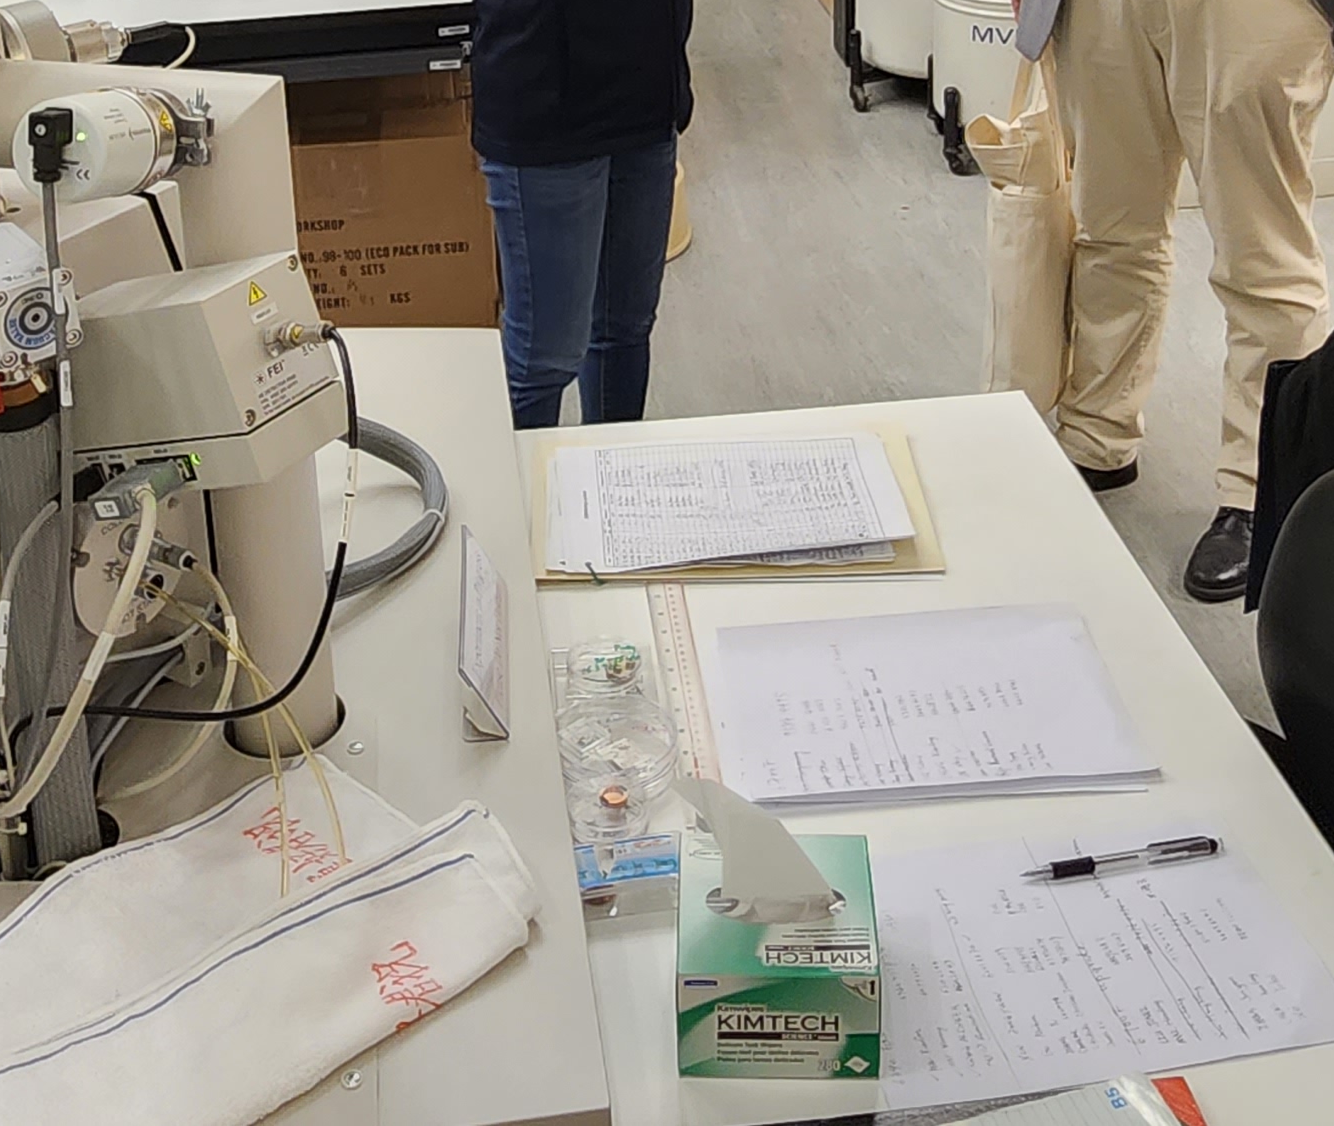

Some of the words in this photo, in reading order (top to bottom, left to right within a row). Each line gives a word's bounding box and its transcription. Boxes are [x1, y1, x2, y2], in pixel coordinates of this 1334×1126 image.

[393, 244, 419, 258] PACK
[422, 243, 441, 256] FOR
[444, 241, 470, 254] SUB)
[339, 264, 348, 277] 6
[359, 262, 386, 276] SETS
[390, 292, 411, 305] KGS
[267, 360, 284, 378] FEI
[766, 952, 872, 964] KIMTECH
[869, 980, 876, 996] 1
[717, 1015, 839, 1031] KIMTECH
[1105, 1087, 1127, 1109] B5
